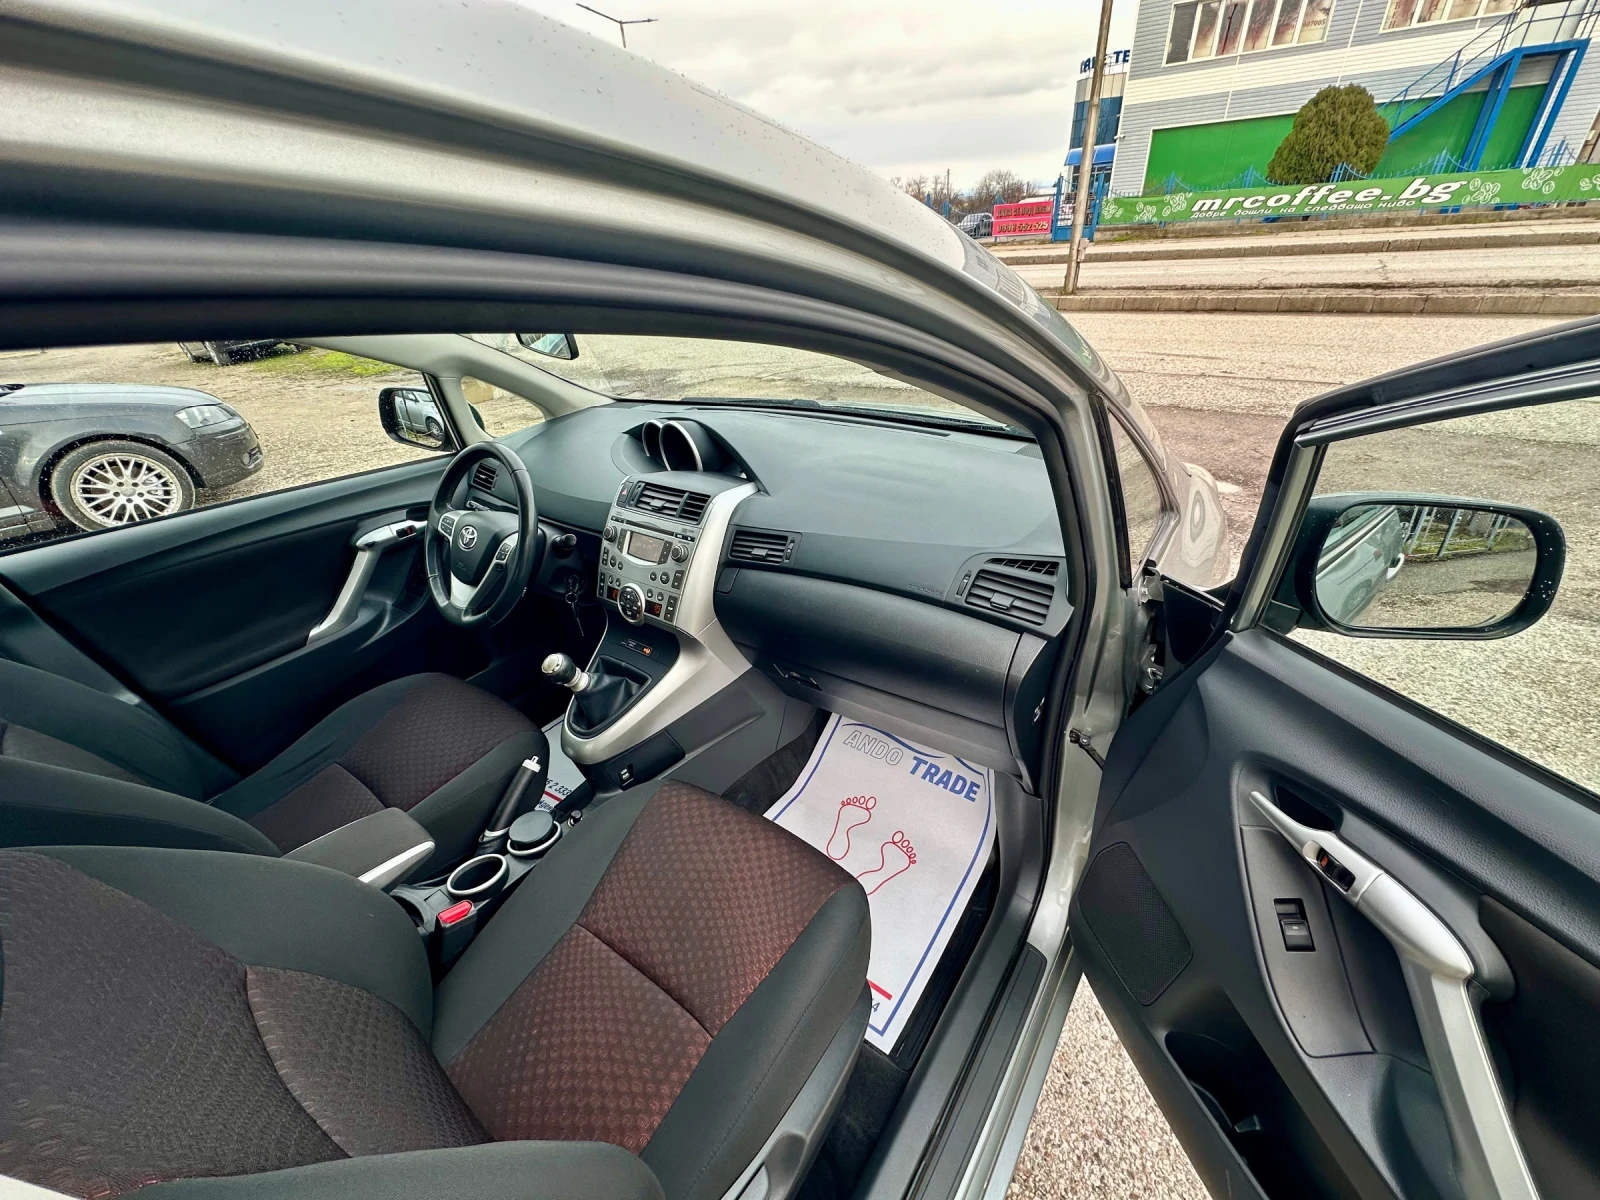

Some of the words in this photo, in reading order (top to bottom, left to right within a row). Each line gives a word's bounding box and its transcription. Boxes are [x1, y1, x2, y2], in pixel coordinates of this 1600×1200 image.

[1191, 177, 1468, 211] mrcoffee.bg
[1190, 211, 1227, 219] Добре
[1304, 203, 1373, 212] следващо
[1377, 200, 1416, 208] ниво
[1034, 221, 1049, 231] 525
[843, 730, 904, 766] ANDO
[909, 755, 981, 803] TRADE
